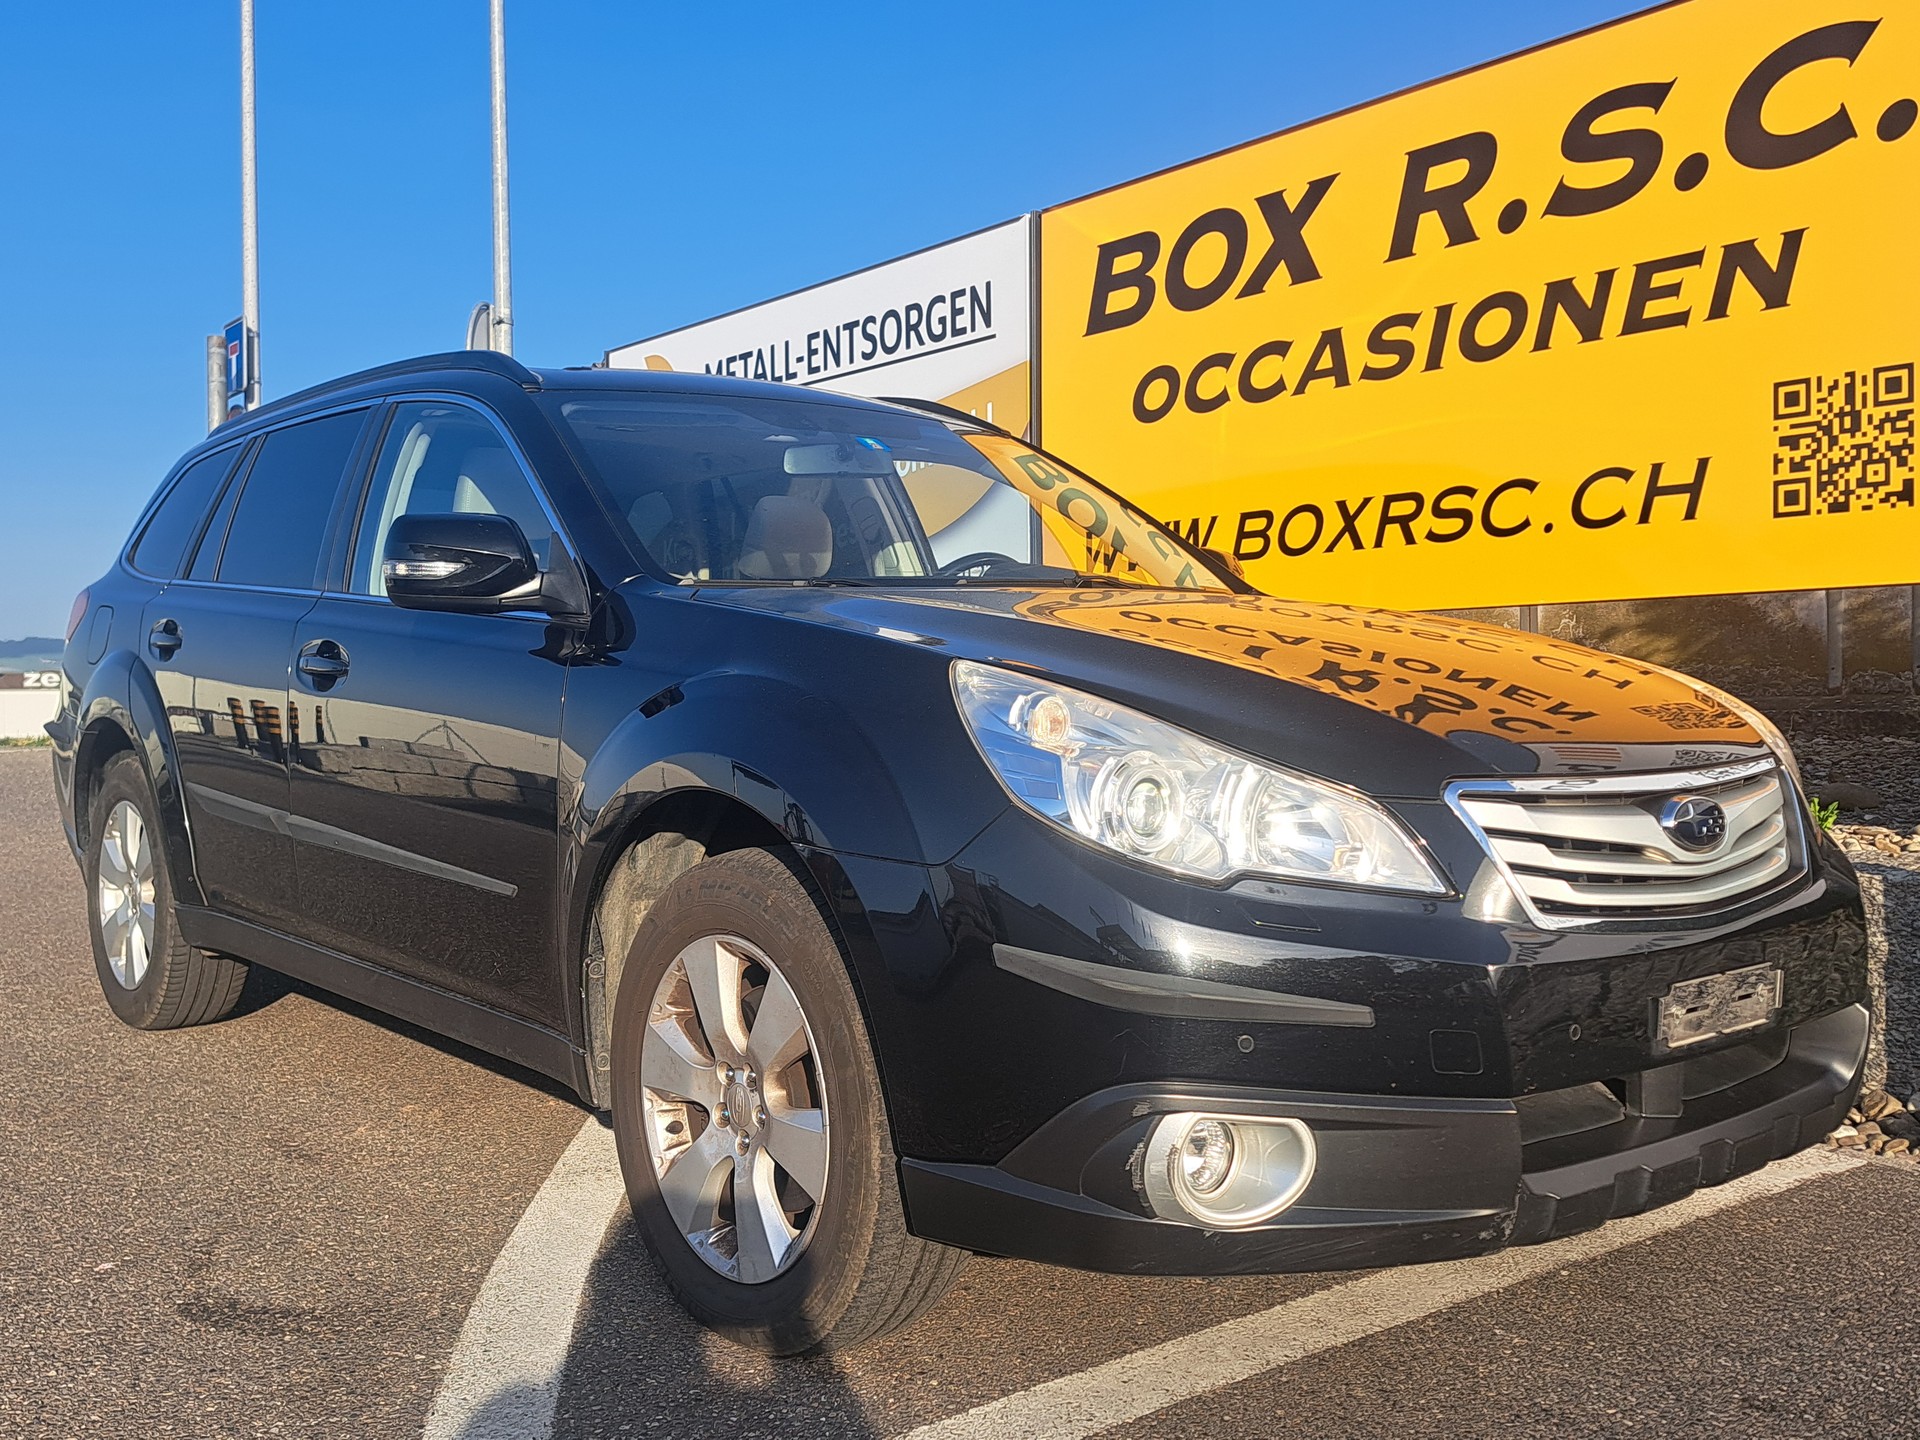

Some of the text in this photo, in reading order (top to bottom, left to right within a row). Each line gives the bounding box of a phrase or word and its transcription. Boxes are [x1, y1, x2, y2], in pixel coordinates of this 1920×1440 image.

[1083, 17, 1919, 338] BOX R.S.C.
[1132, 227, 1810, 424] OCCASIONEN
